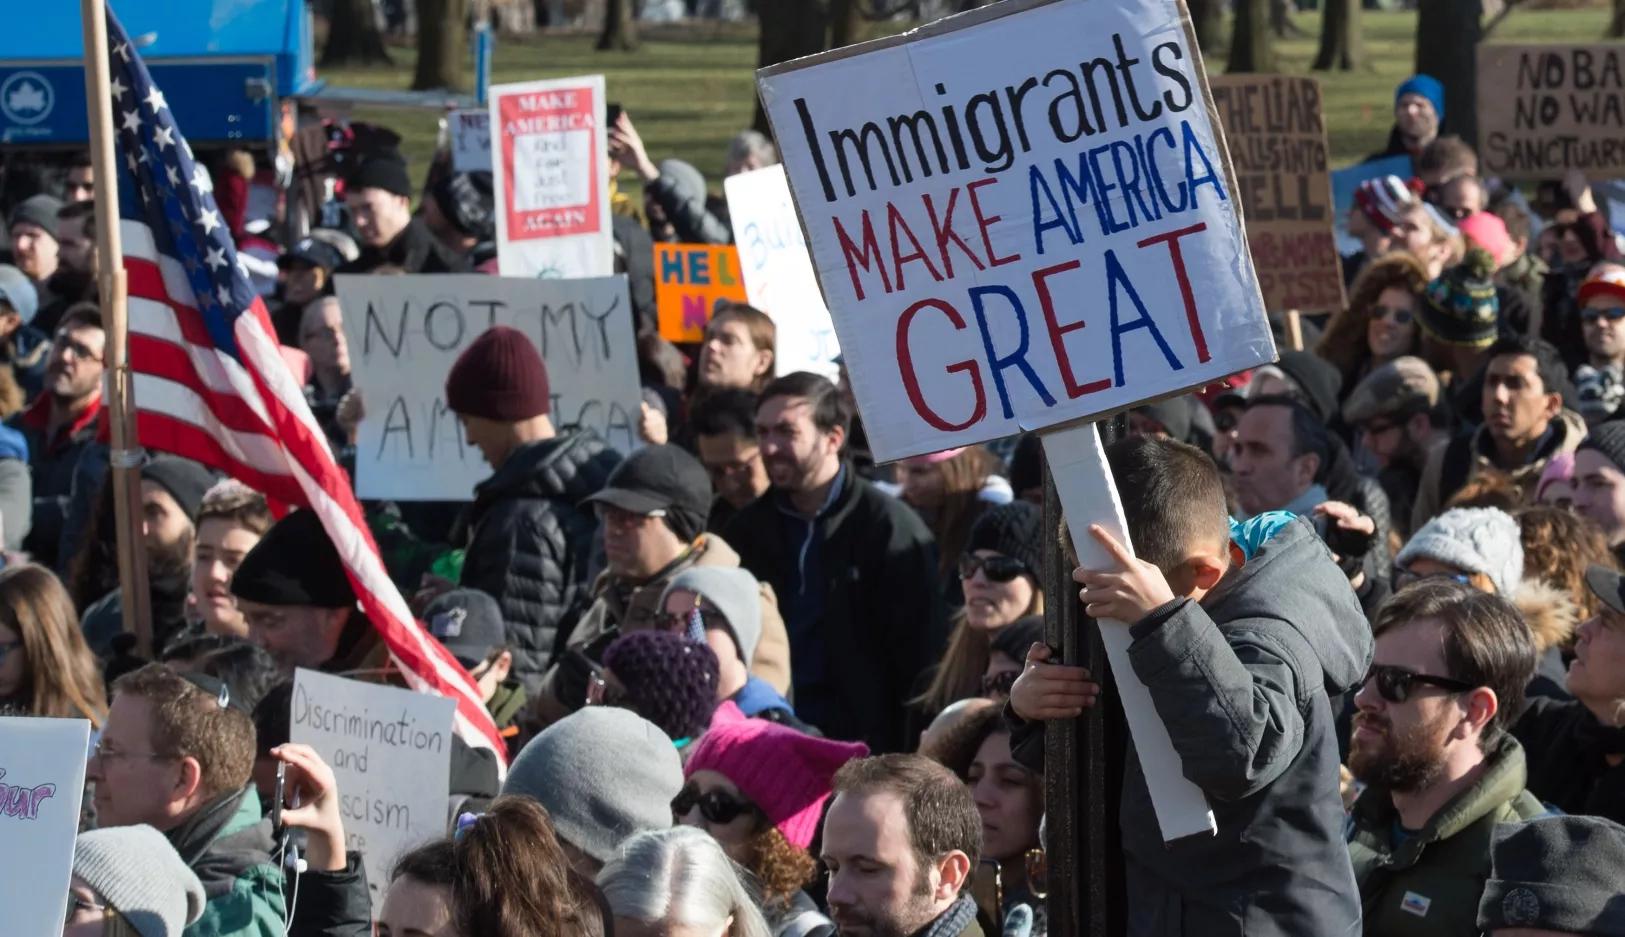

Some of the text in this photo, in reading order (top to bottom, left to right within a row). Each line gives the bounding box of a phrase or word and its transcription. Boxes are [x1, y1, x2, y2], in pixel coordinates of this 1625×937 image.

[1516, 49, 1624, 90] NO BA
[519, 91, 577, 112] MAKE
[794, 33, 1193, 201] Immigrants
[1514, 92, 1625, 130] NO WA
[503, 112, 595, 136] AMERICA
[1231, 135, 1283, 172] ALLS
[523, 209, 586, 232] AGAIN
[832, 120, 1227, 301] MAKE AMERICA
[661, 250, 744, 286] HEL
[364, 295, 619, 360] NOT MY
[682, 294, 728, 330] N
[896, 222, 1211, 432] GREAT
[377, 393, 633, 461] AMICA
[294, 683, 442, 753] Discrimination
[334, 746, 368, 773] and
[341, 789, 410, 831] scism
